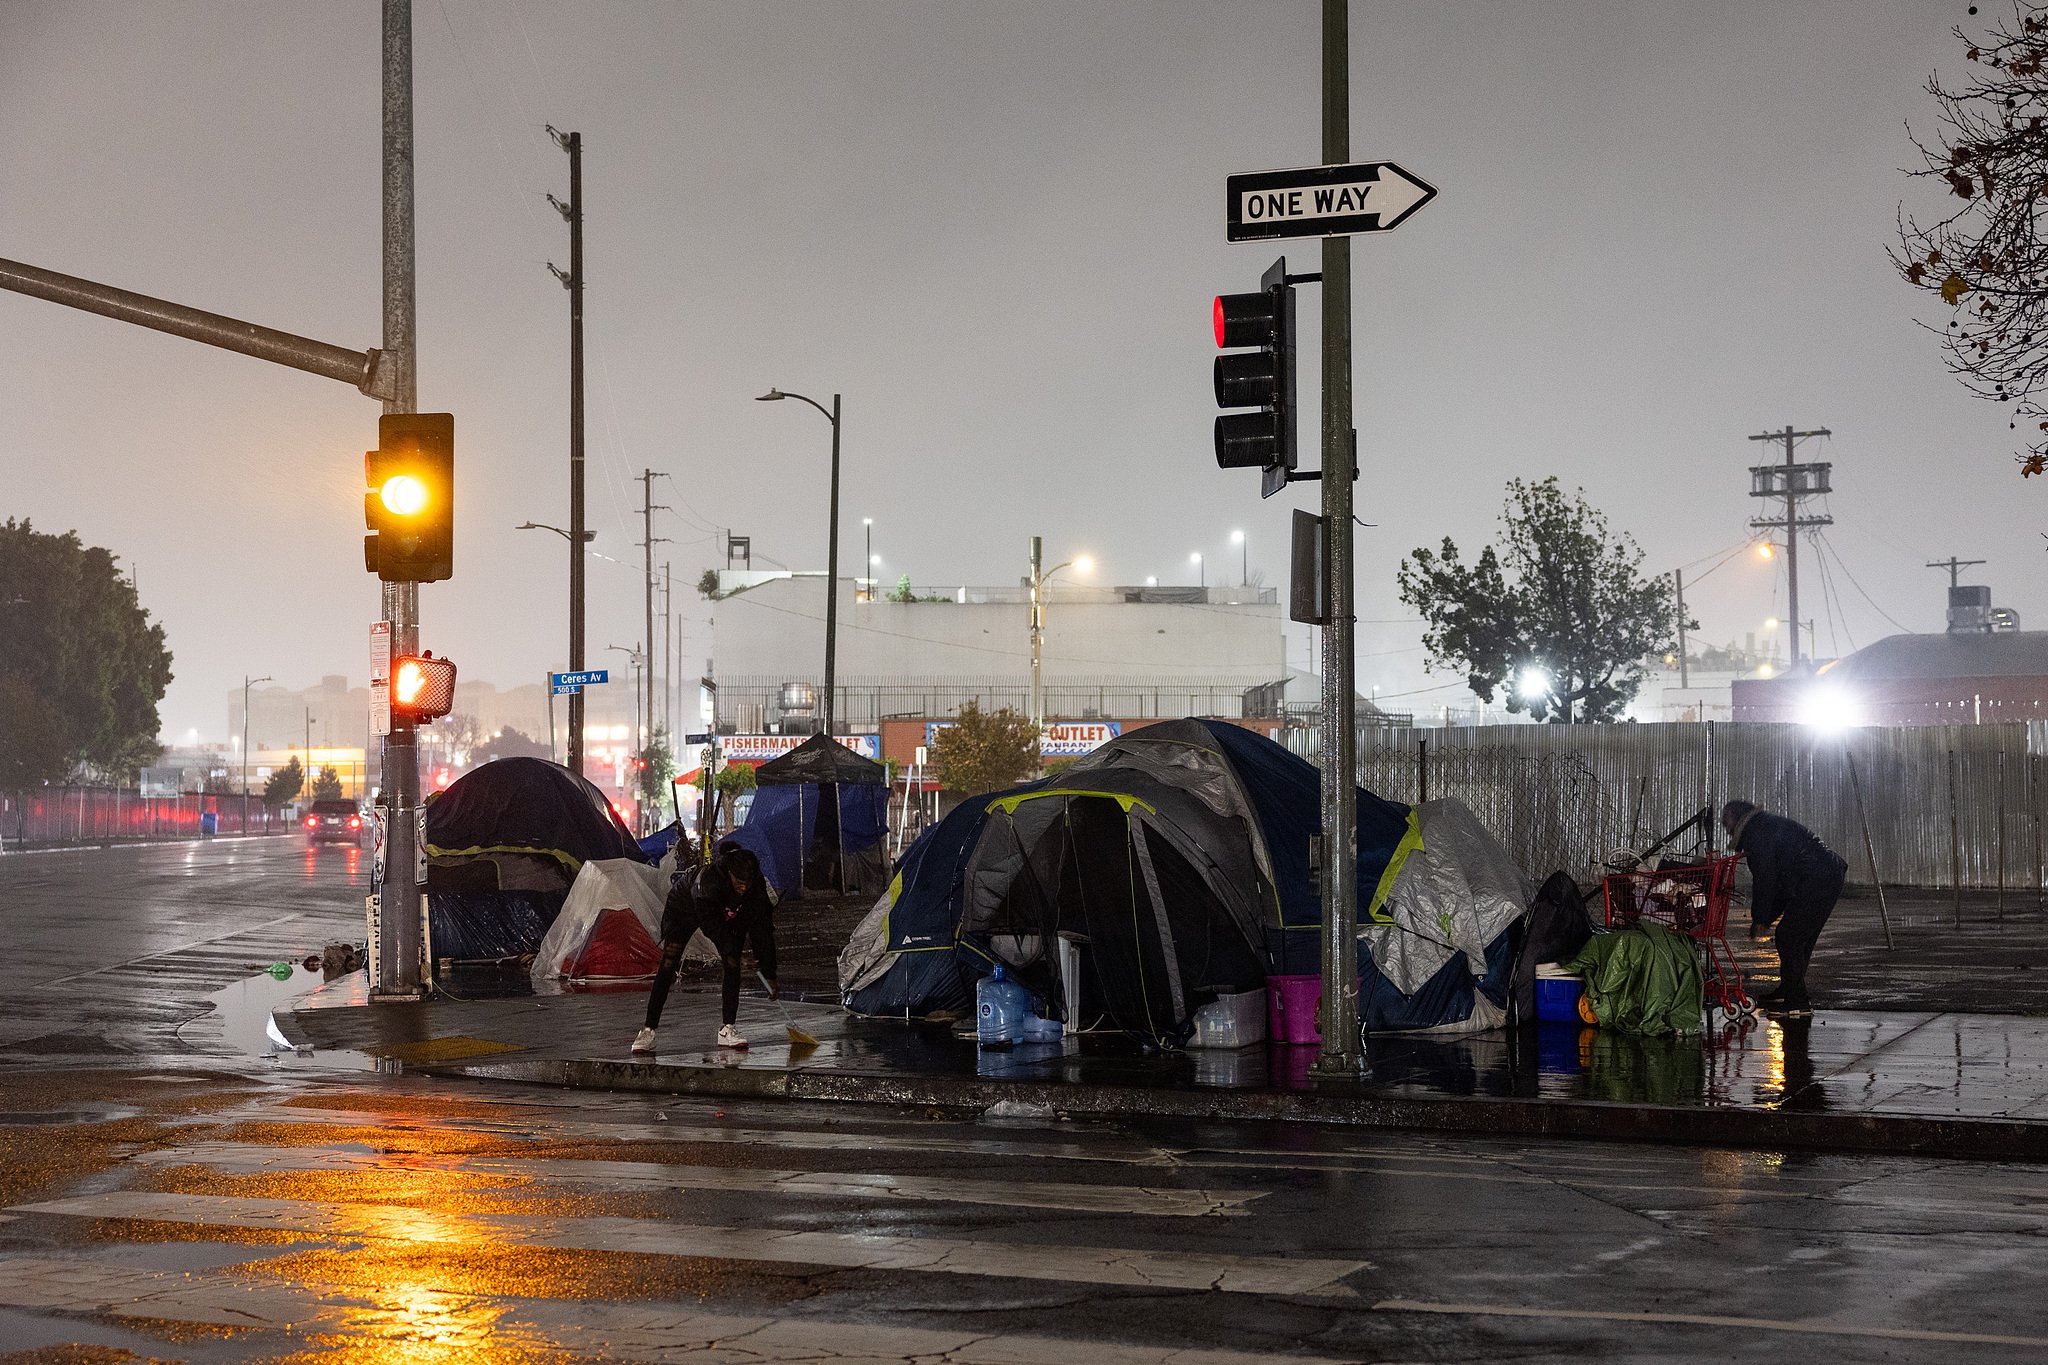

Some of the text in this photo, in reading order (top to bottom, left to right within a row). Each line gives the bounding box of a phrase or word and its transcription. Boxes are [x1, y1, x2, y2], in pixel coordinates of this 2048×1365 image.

[1247, 186, 1371, 219] ONE WAY
[561, 672, 601, 684] Ceres Av
[1049, 726, 1105, 741] OUTLET
